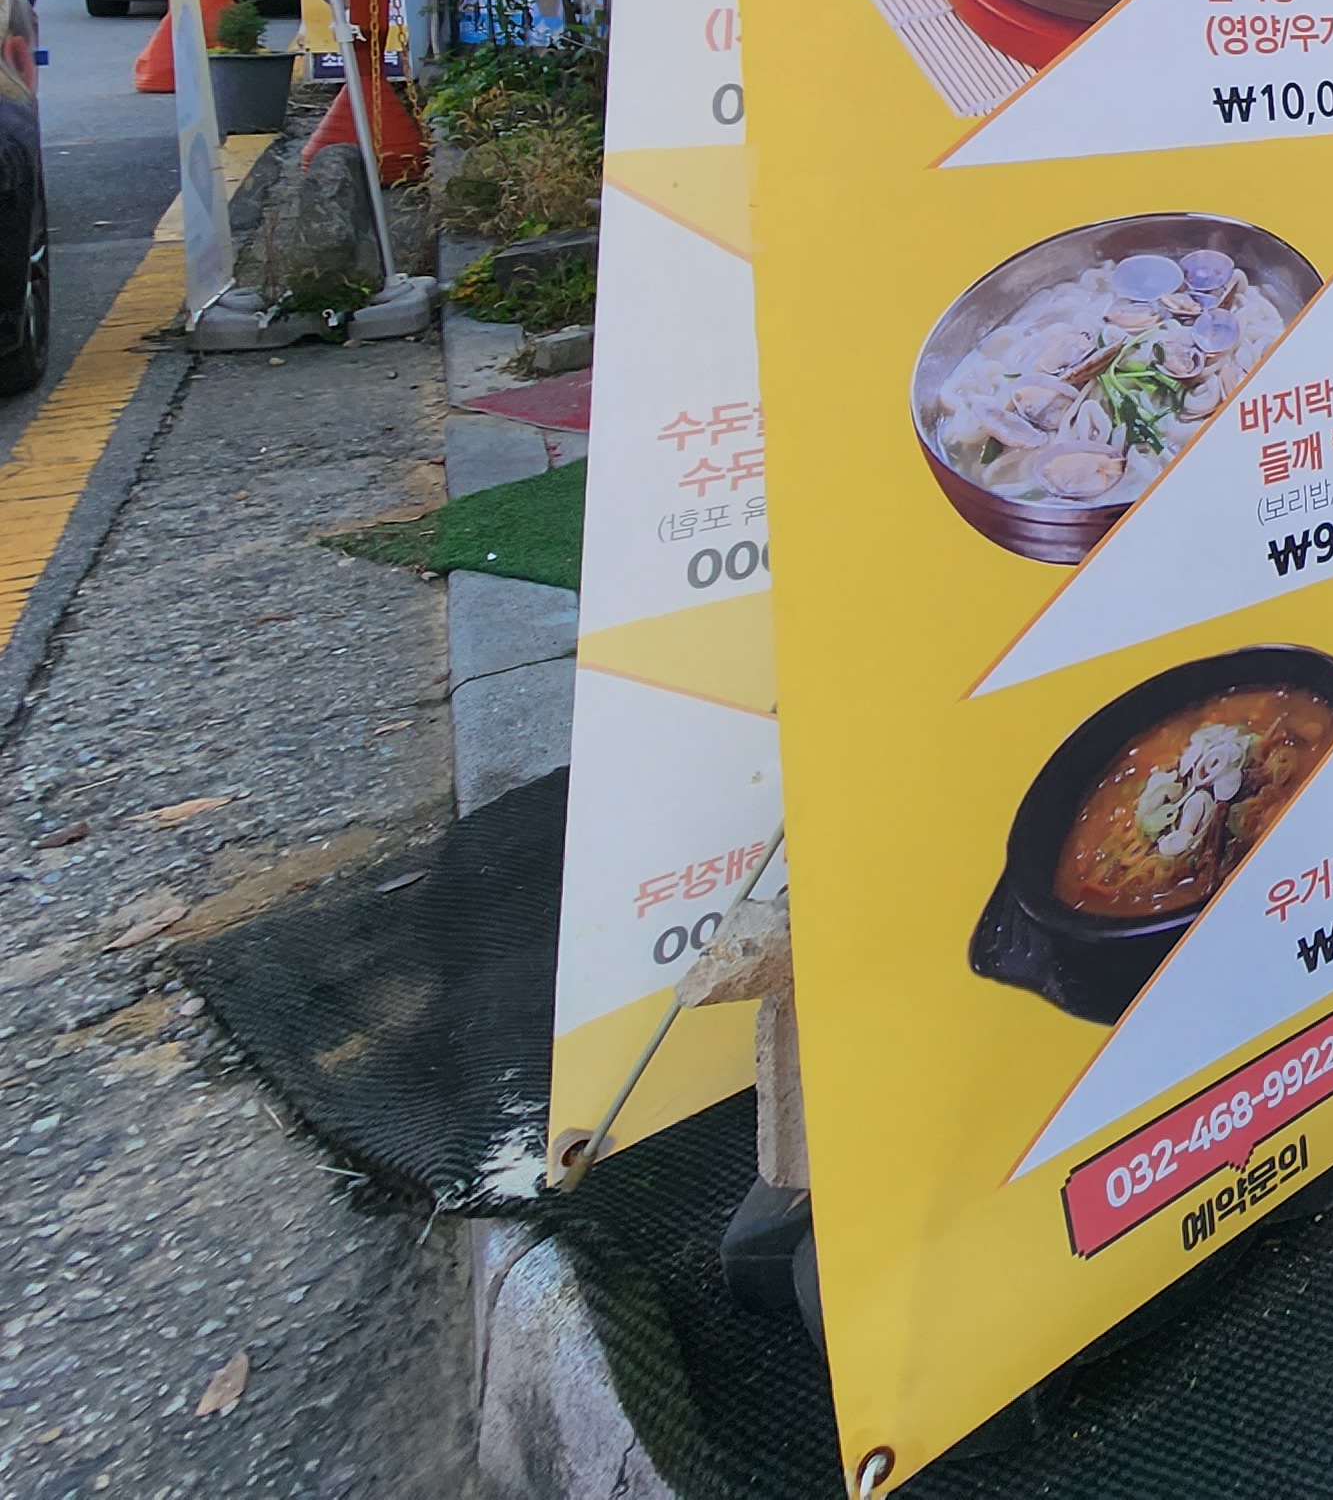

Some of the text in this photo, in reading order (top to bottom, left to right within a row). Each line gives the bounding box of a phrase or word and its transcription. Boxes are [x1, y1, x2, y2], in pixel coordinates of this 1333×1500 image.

[1239, 379, 1333, 434] 바지락
[1258, 430, 1323, 486] 들깨
[1181, 1133, 1309, 1252] 예약문의
